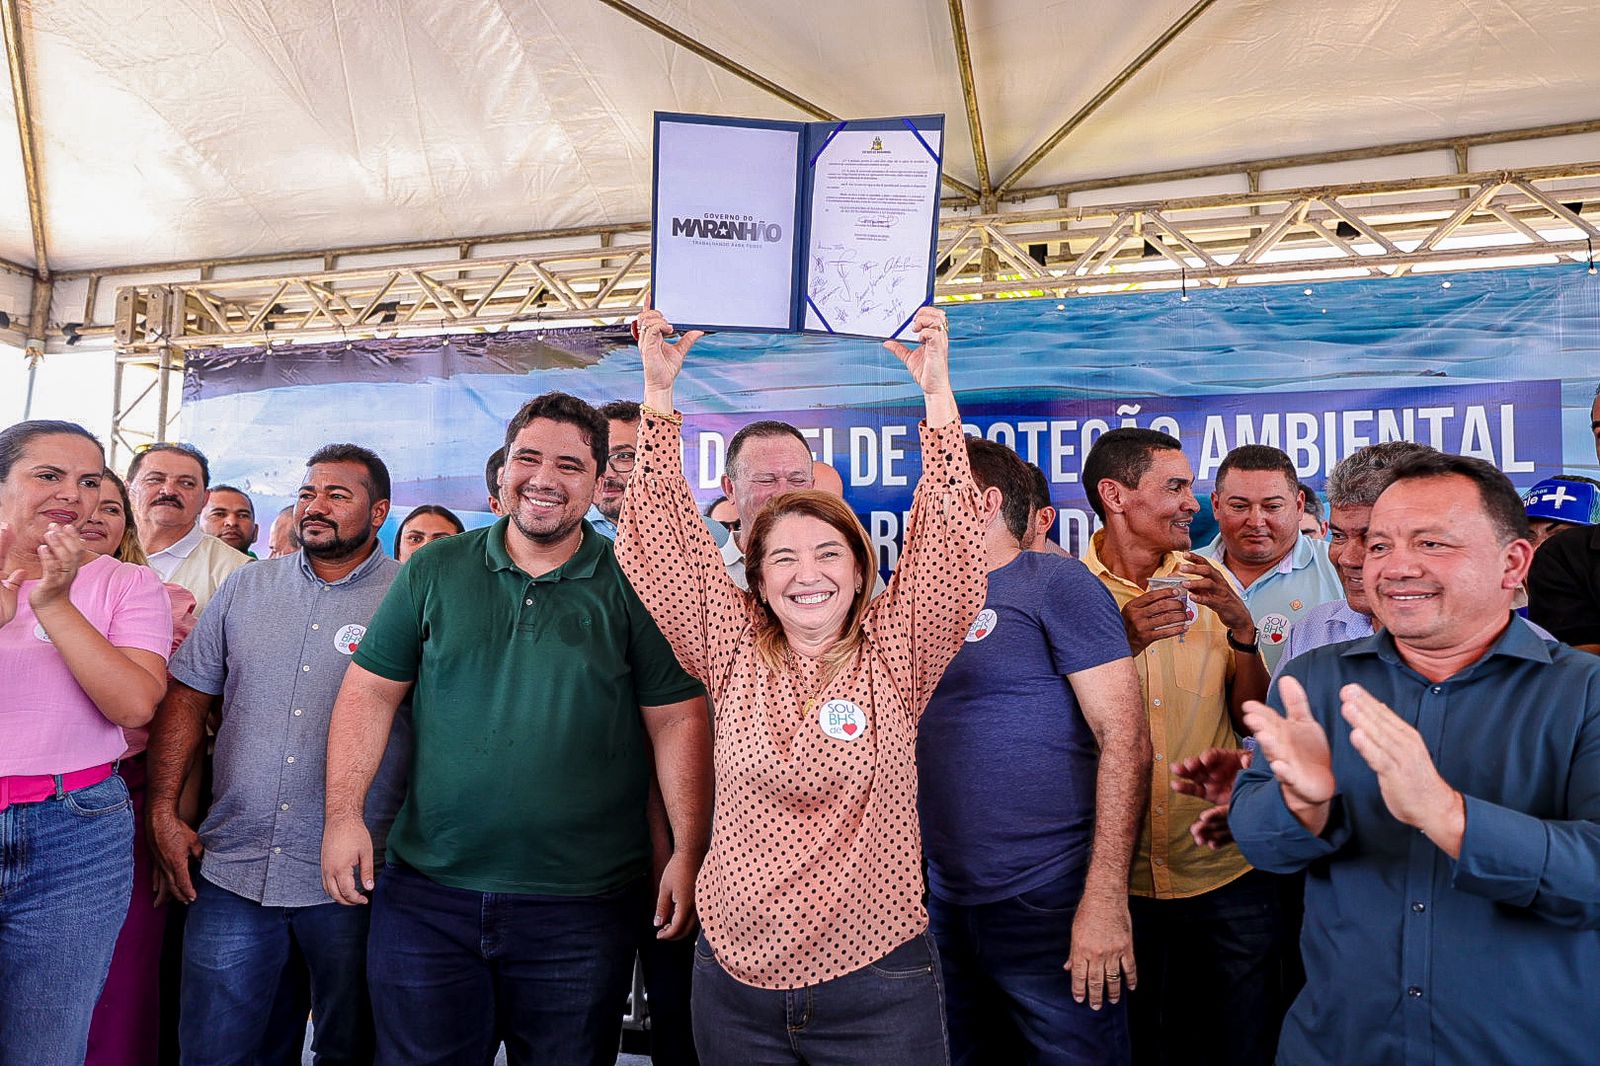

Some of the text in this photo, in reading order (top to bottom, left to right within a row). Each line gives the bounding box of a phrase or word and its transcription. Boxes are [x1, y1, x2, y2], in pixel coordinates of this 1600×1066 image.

[704, 212, 754, 222] GOVERNO DO
[672, 217, 782, 243] MARANHÃO
[850, 425, 908, 487] DE
[1266, 616, 1287, 627] SOU
[1264, 623, 1284, 635] BHS
[827, 703, 855, 714] SOU
[829, 713, 856, 726] BHS
